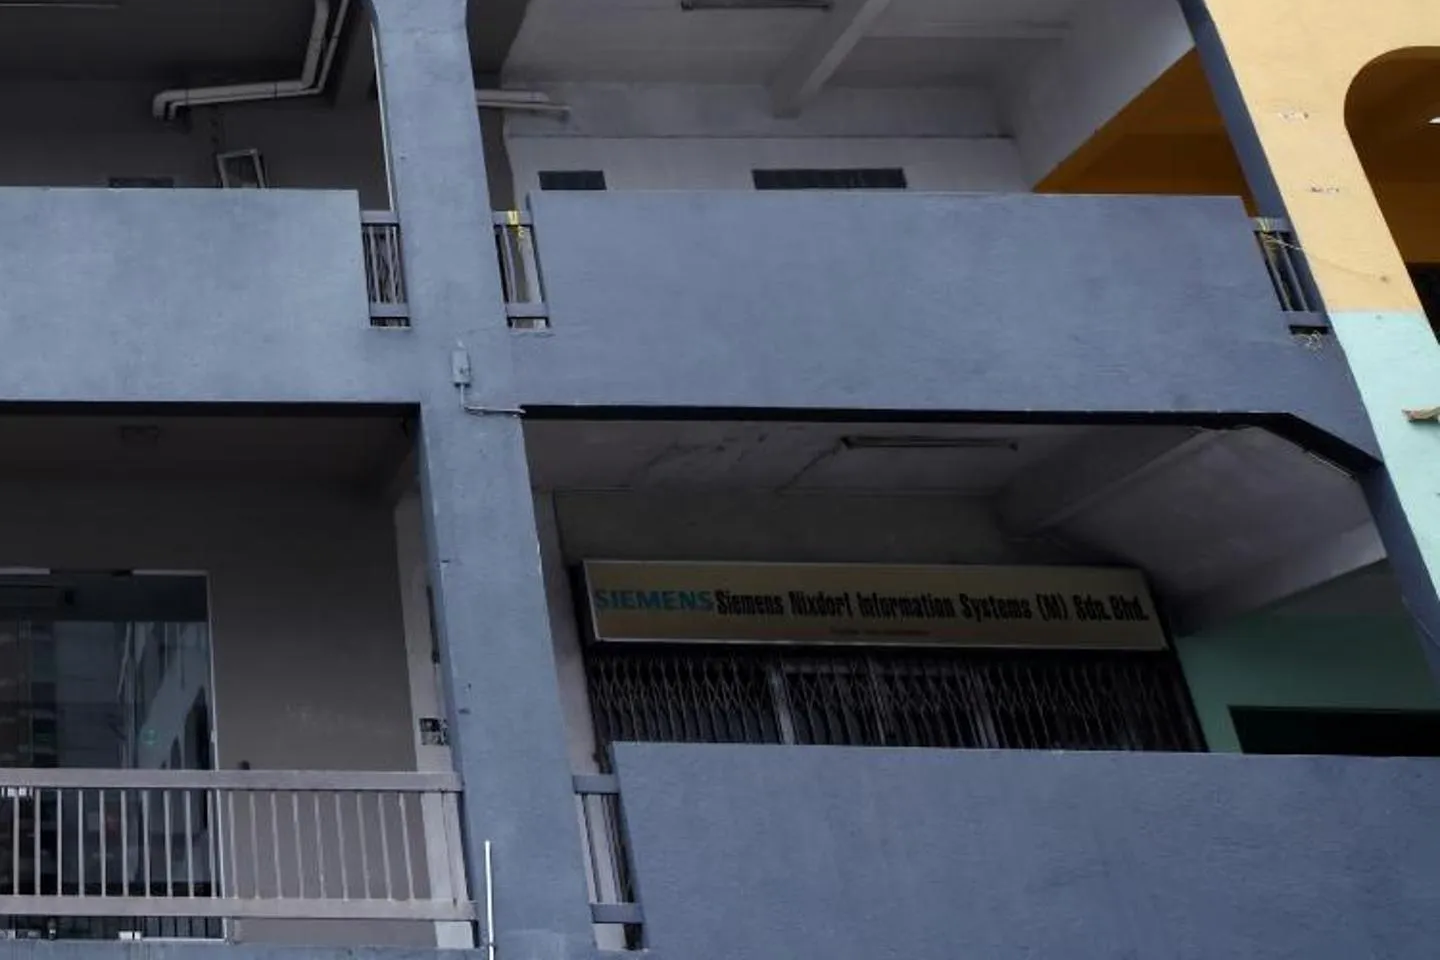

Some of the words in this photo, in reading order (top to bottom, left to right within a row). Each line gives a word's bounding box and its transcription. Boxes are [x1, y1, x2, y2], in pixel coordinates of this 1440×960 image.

[594, 589, 713, 611] SIEMENS
[714, 590, 784, 616] Siemens
[959, 593, 1033, 623] Systems
